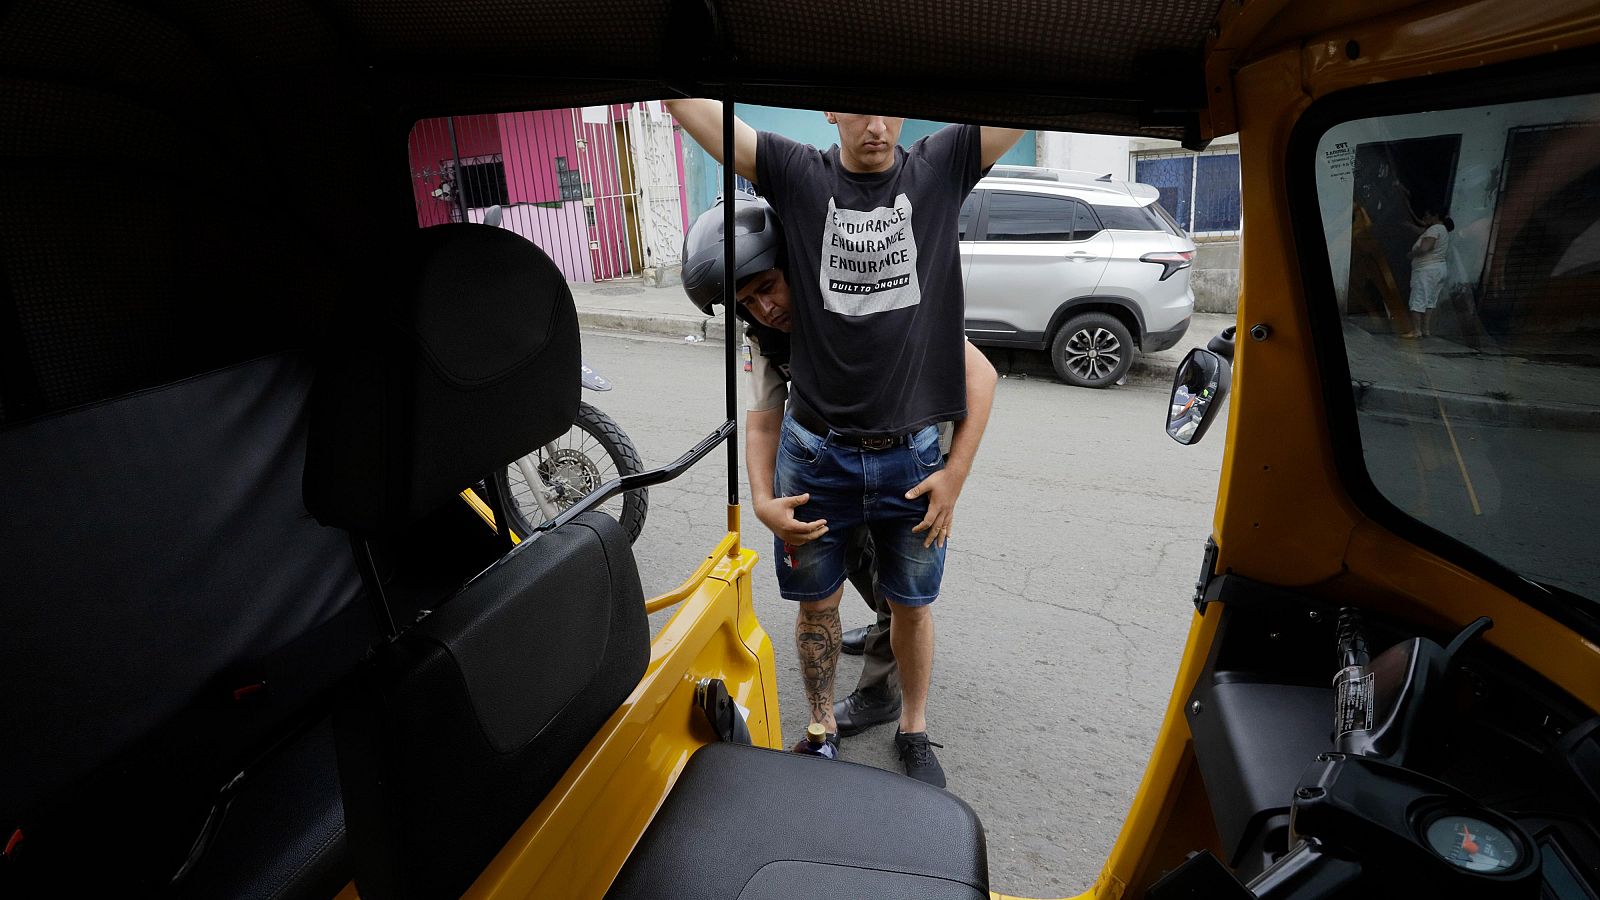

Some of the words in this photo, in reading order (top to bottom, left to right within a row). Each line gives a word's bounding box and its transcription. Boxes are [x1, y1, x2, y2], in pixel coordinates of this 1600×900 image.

[831, 227, 906, 253] ENDURANCE
[832, 282, 858, 292] BUILT
[874, 277, 908, 290] ONQUER
